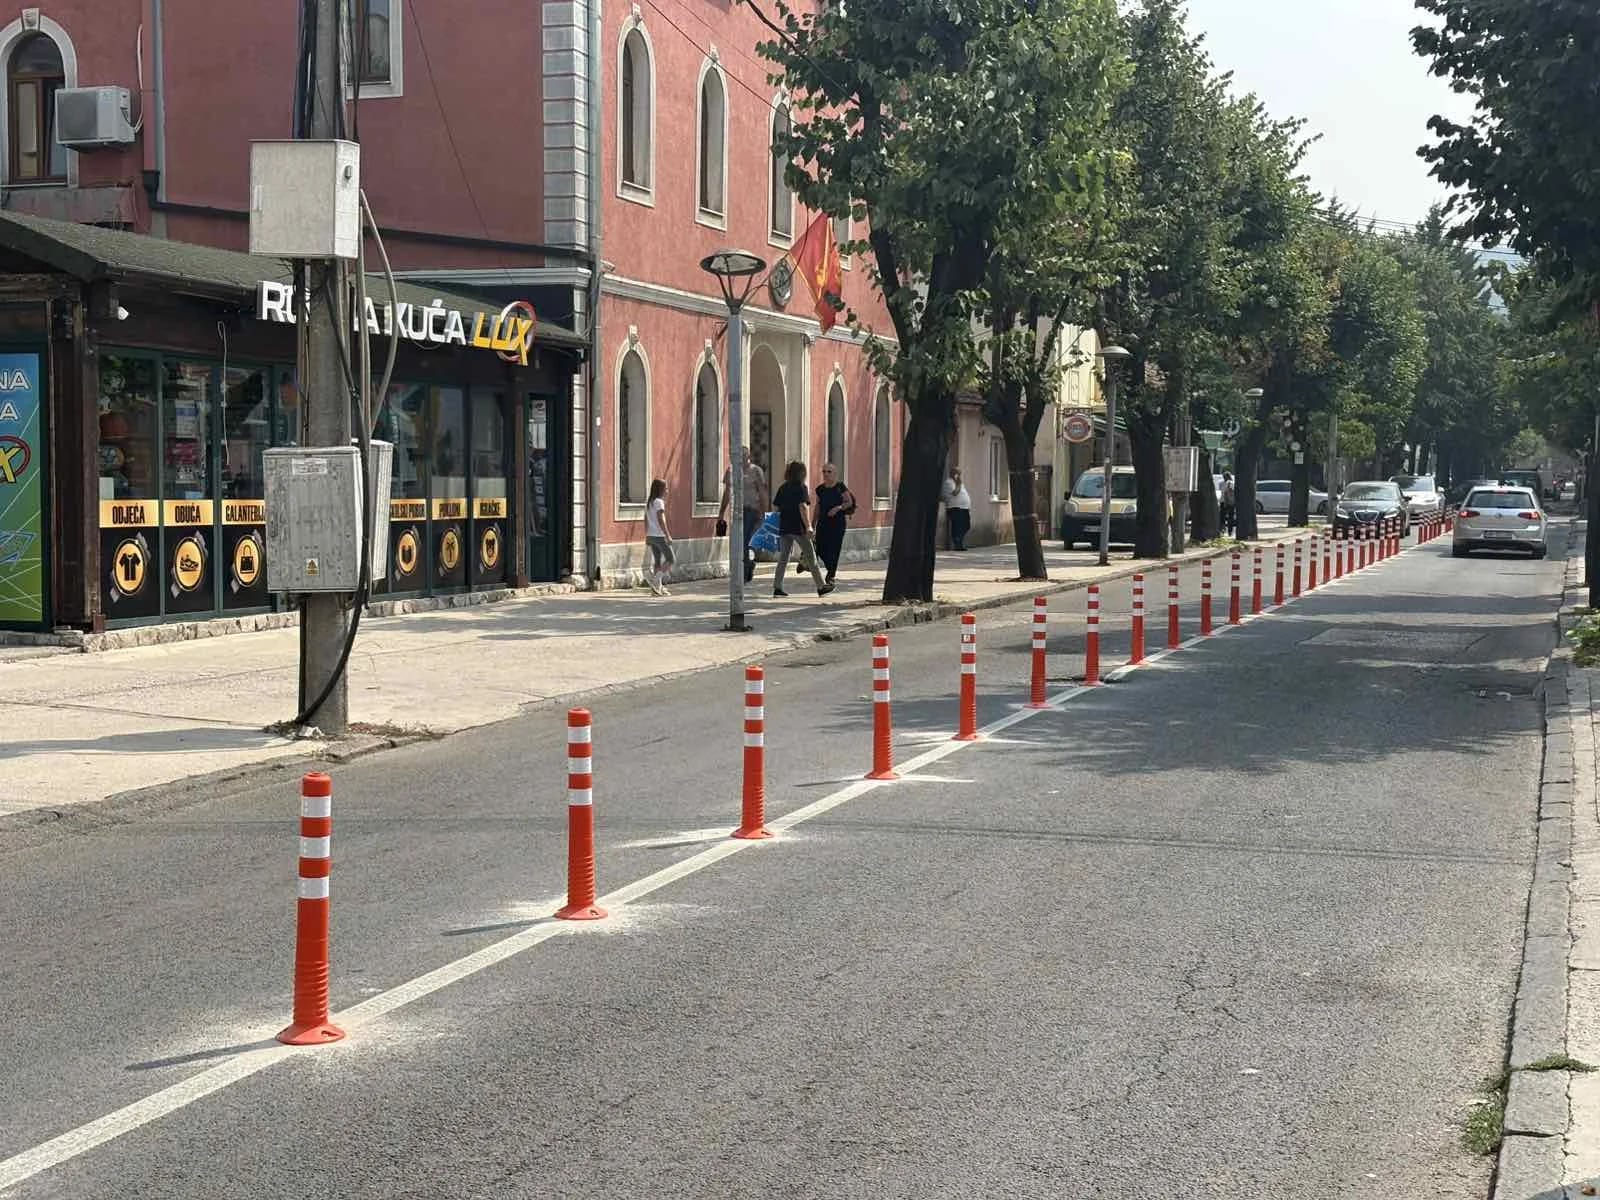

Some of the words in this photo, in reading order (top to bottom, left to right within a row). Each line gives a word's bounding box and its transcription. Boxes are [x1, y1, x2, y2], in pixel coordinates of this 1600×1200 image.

[257, 280, 380, 335] ROA
[384, 299, 467, 345] KUĆA
[471, 311, 534, 366] LUX
[112, 503, 146, 525] ODJEĆA
[174, 503, 201, 524] OBUĆA
[225, 504, 266, 523] GALANTERIJ
